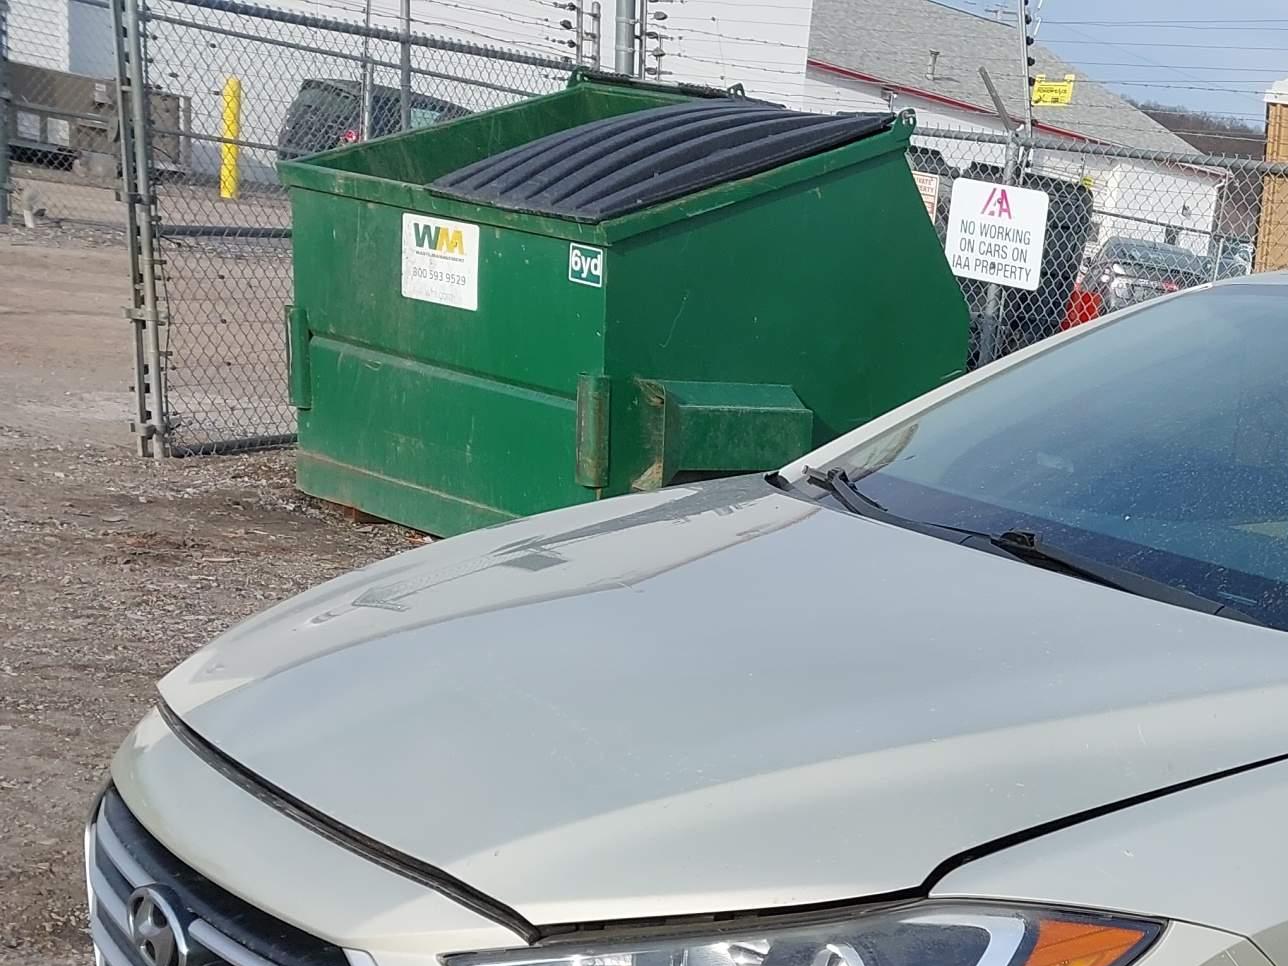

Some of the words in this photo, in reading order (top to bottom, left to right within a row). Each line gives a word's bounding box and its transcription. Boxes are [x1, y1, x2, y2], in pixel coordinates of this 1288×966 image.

[413, 222, 465, 256] WM
[960, 219, 976, 235] NO
[979, 222, 1031, 245] WORKING
[572, 249, 602, 278] 6yd
[960, 237, 975, 253] ON
[978, 241, 1008, 260] CARS
[1011, 247, 1028, 263] ON
[429, 269, 443, 281] 593
[445, 272, 466, 286] 9529
[952, 254, 970, 271] IAA
[974, 258, 1032, 282] PROPERTY
